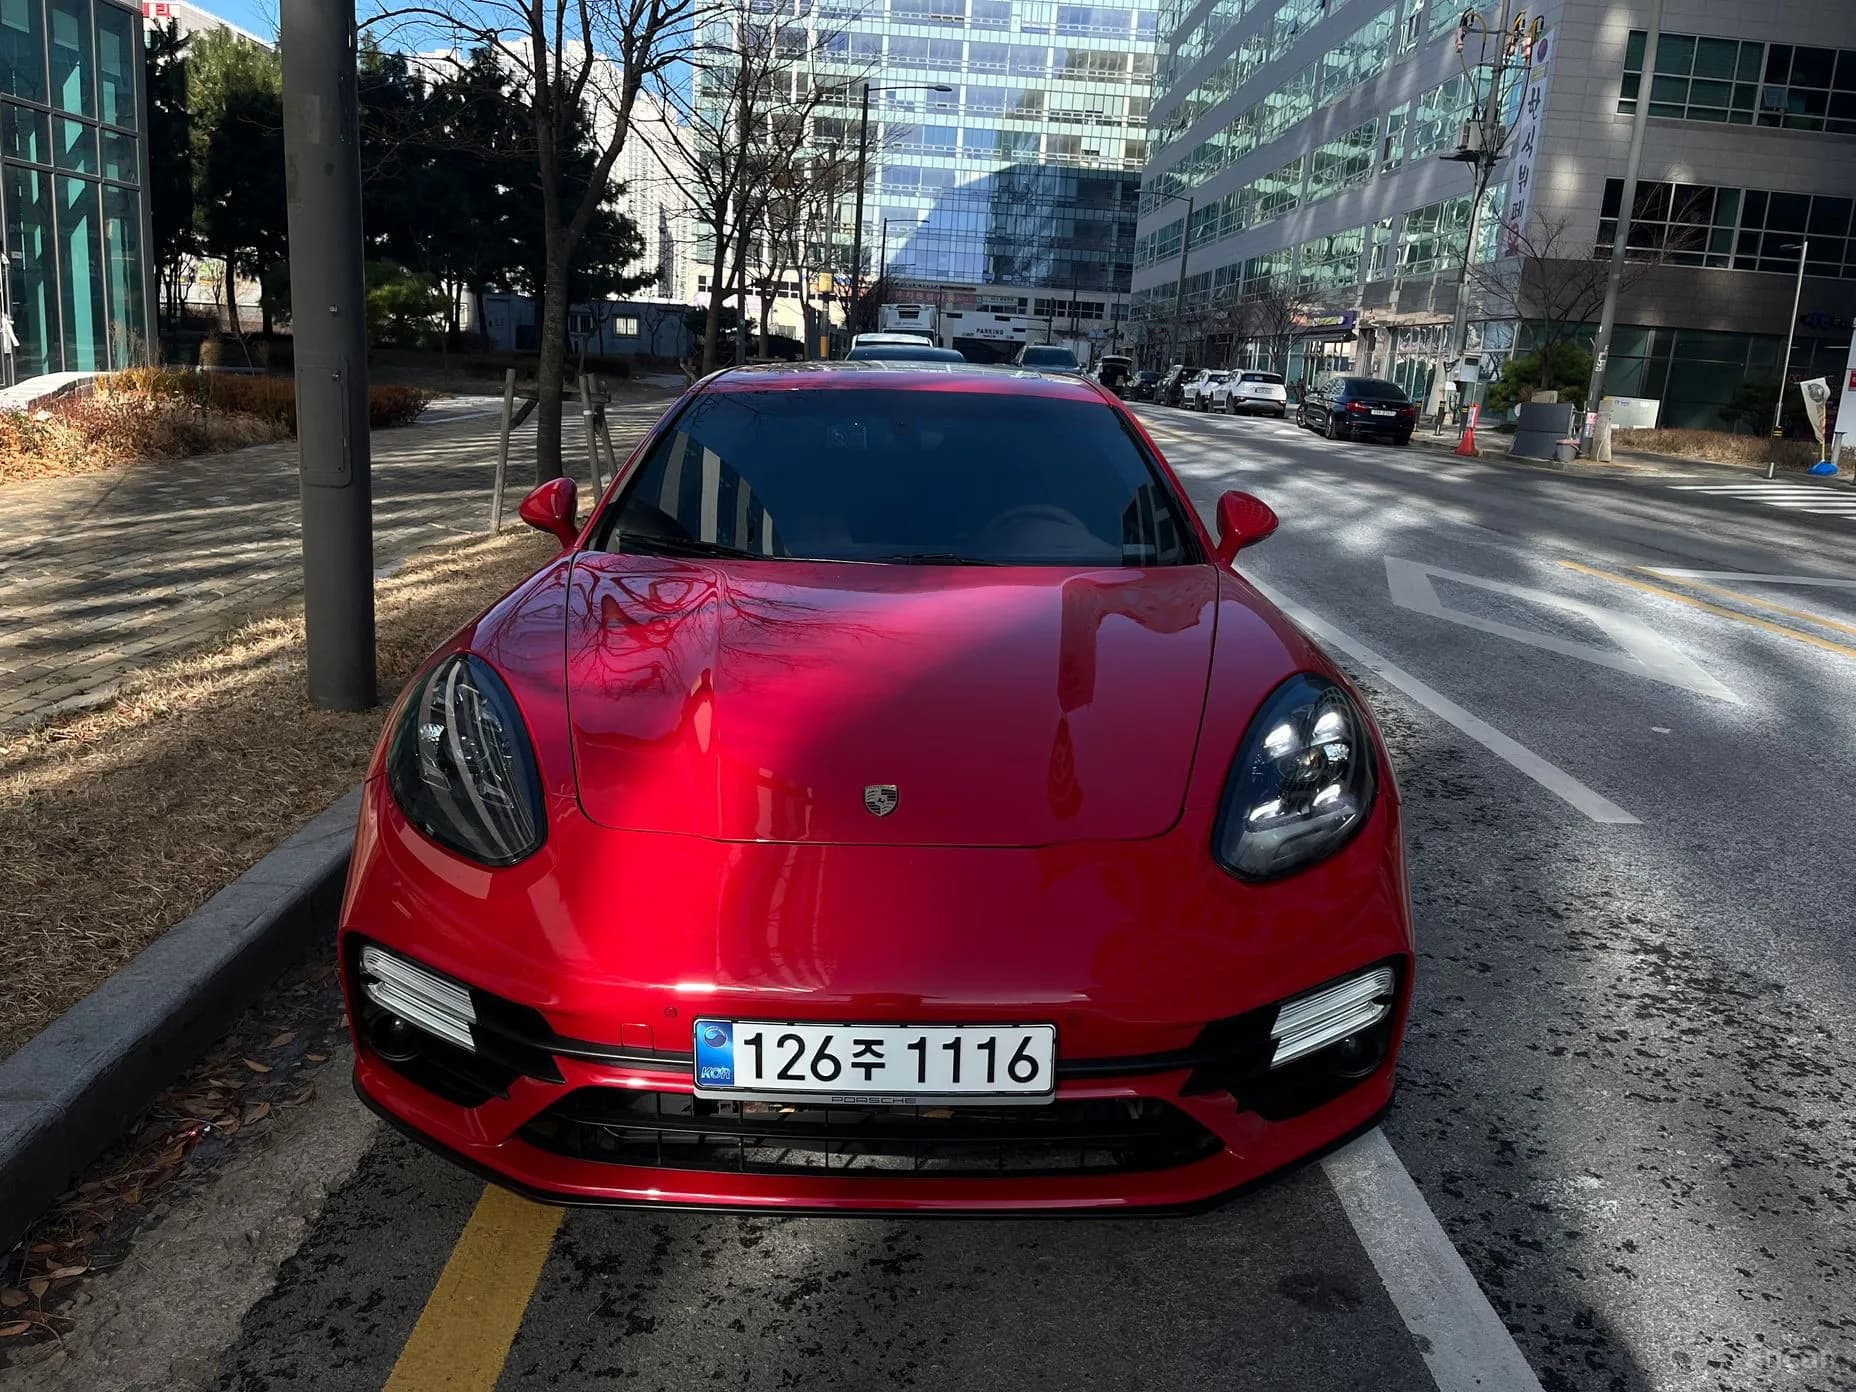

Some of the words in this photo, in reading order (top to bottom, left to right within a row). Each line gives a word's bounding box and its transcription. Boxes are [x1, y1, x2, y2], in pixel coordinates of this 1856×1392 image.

[1511, 87, 1541, 220] 한식뷔페
[701, 1066, 731, 1080] KOR
[743, 1031, 886, 1082] 126주
[907, 1036, 1040, 1084] 1116
[831, 1096, 917, 1105] PORSCHE
